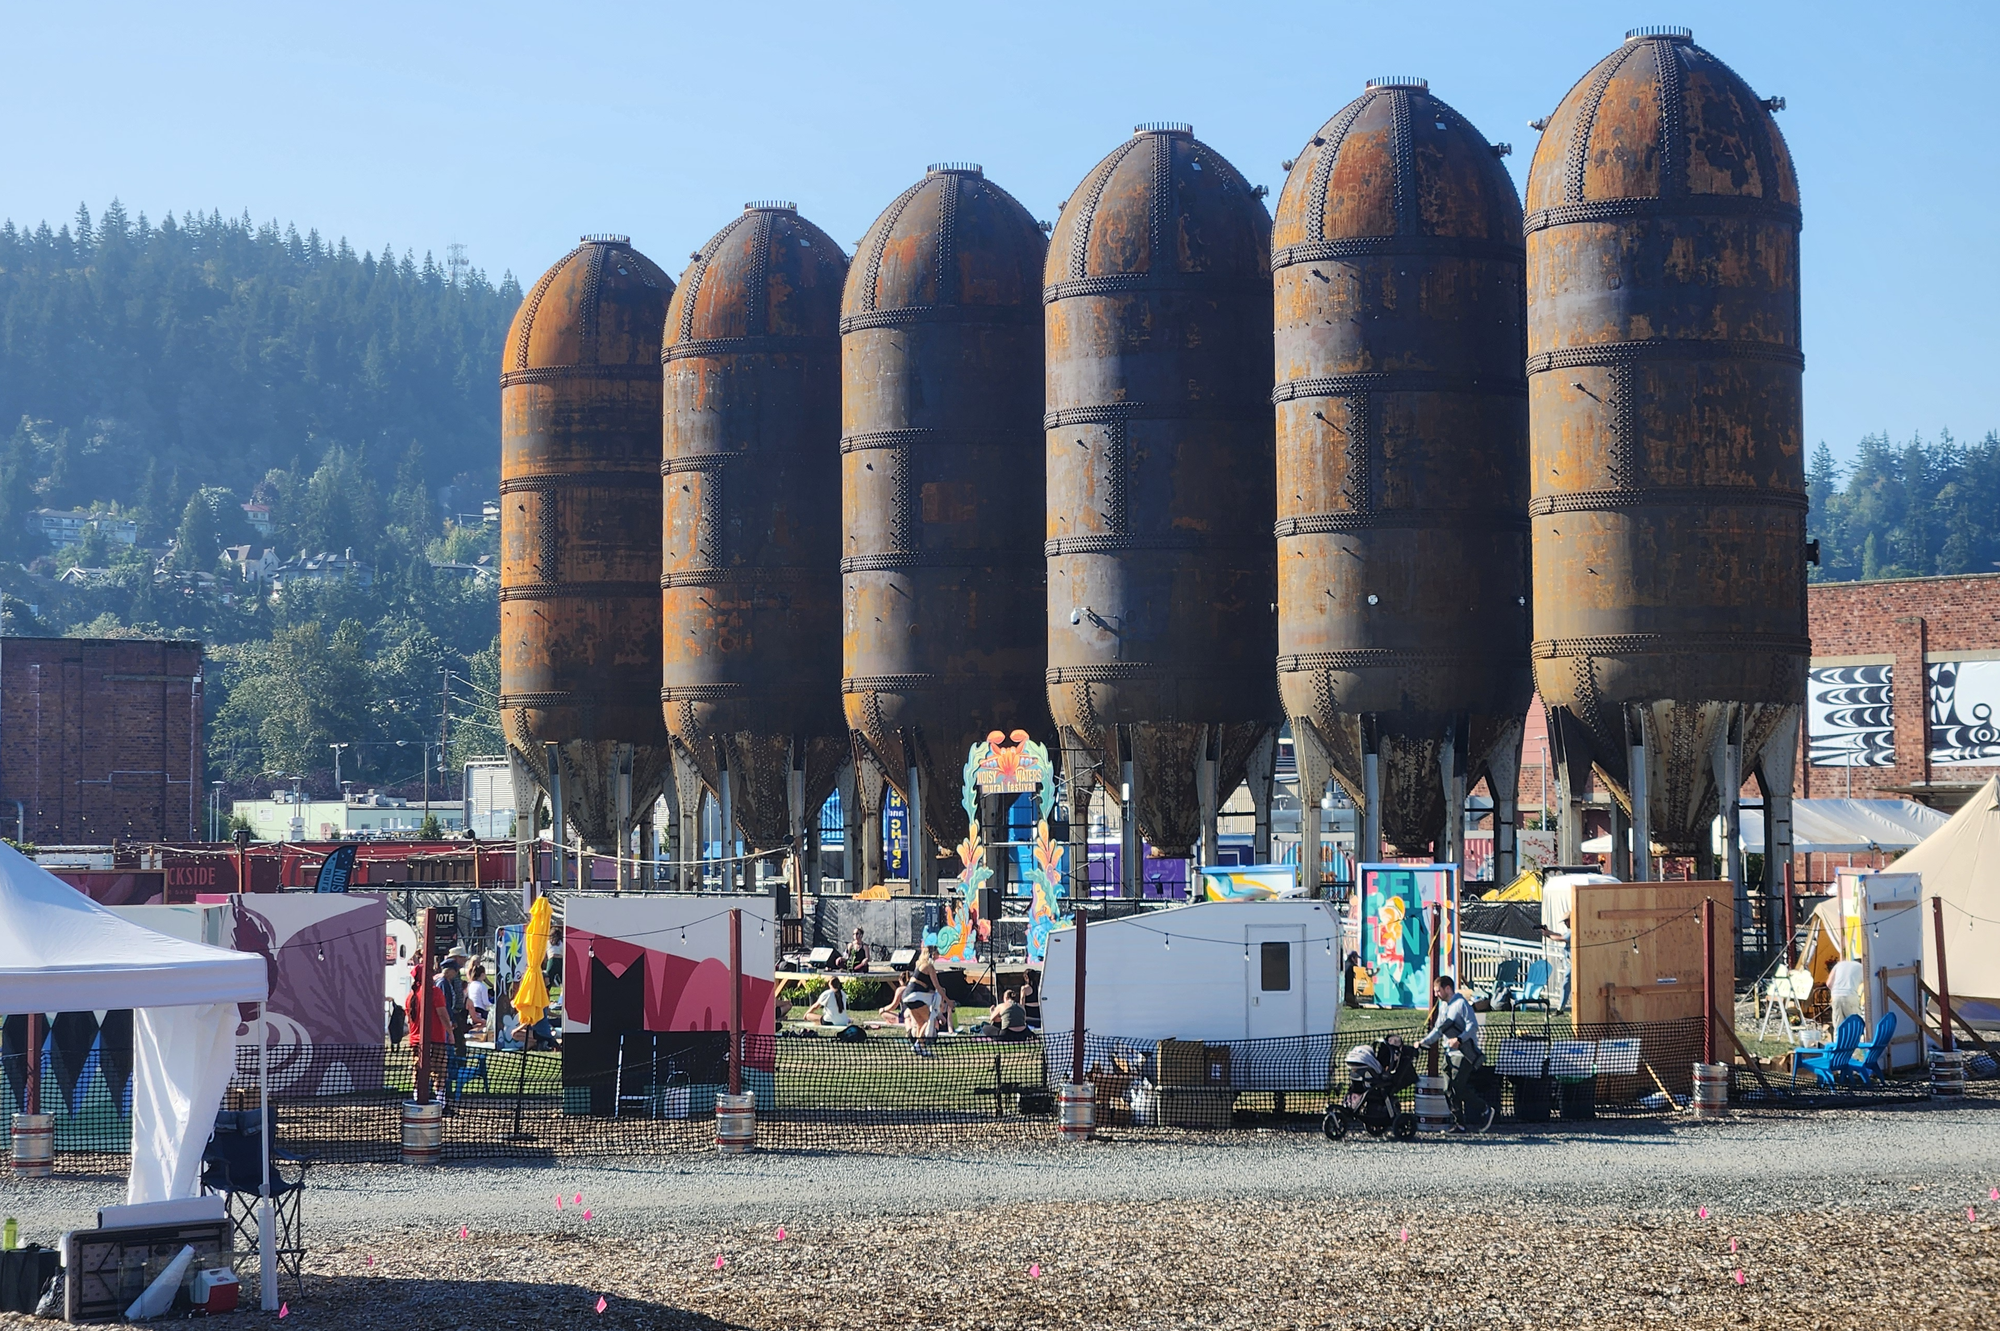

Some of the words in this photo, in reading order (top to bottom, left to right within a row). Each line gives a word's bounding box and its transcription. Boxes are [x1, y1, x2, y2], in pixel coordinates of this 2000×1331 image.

[977, 771, 997, 784] NOISY
[1016, 770, 1042, 783] WATERS
[1007, 781, 1036, 792] festival
